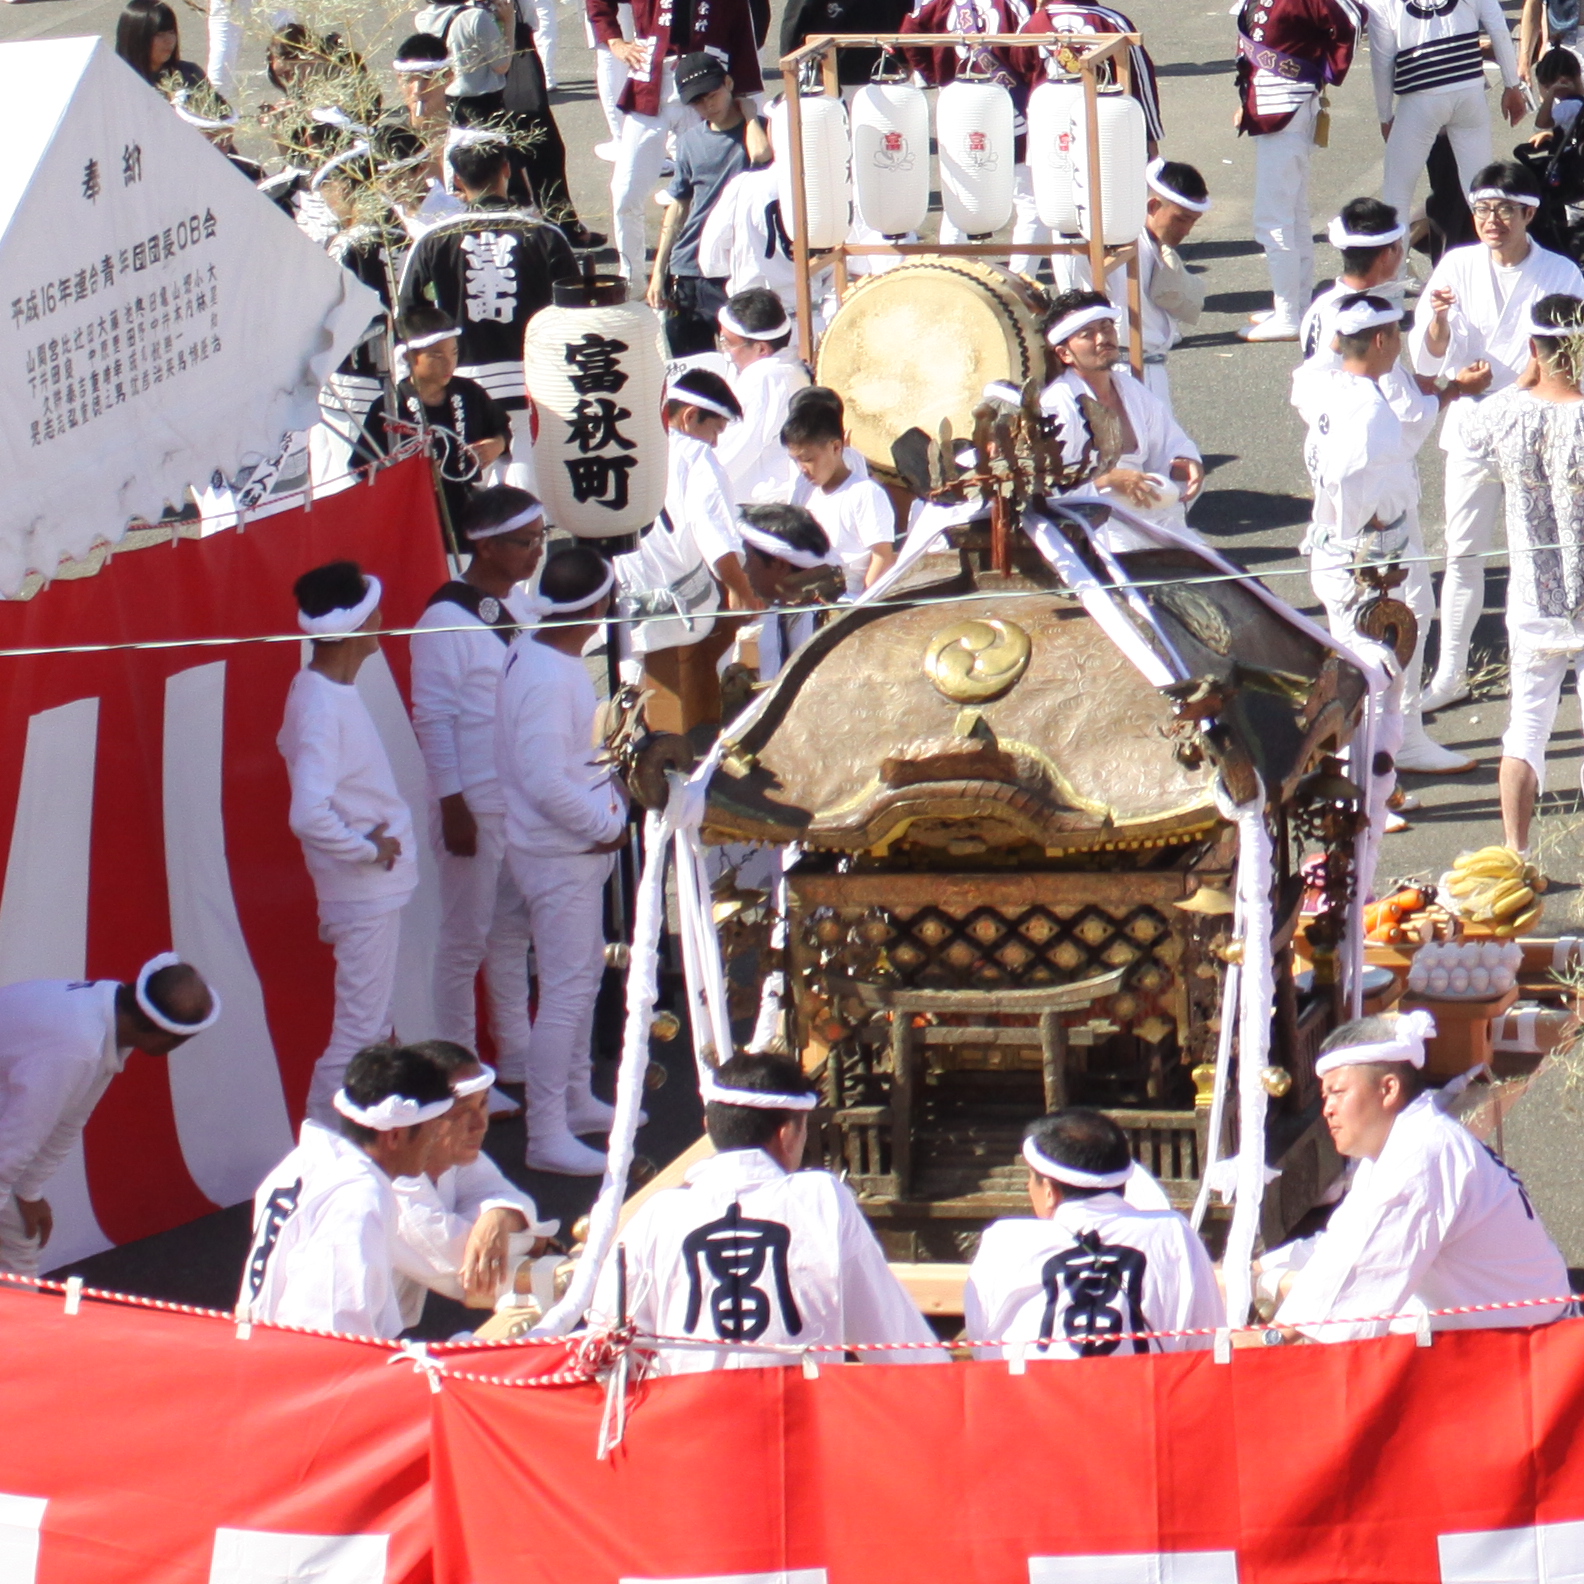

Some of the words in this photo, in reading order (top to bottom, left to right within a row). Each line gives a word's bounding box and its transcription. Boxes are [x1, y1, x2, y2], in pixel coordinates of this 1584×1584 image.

[563, 332, 639, 512] 富秋町
[681, 1201, 803, 1342] 富
[1038, 1228, 1148, 1358] 富
